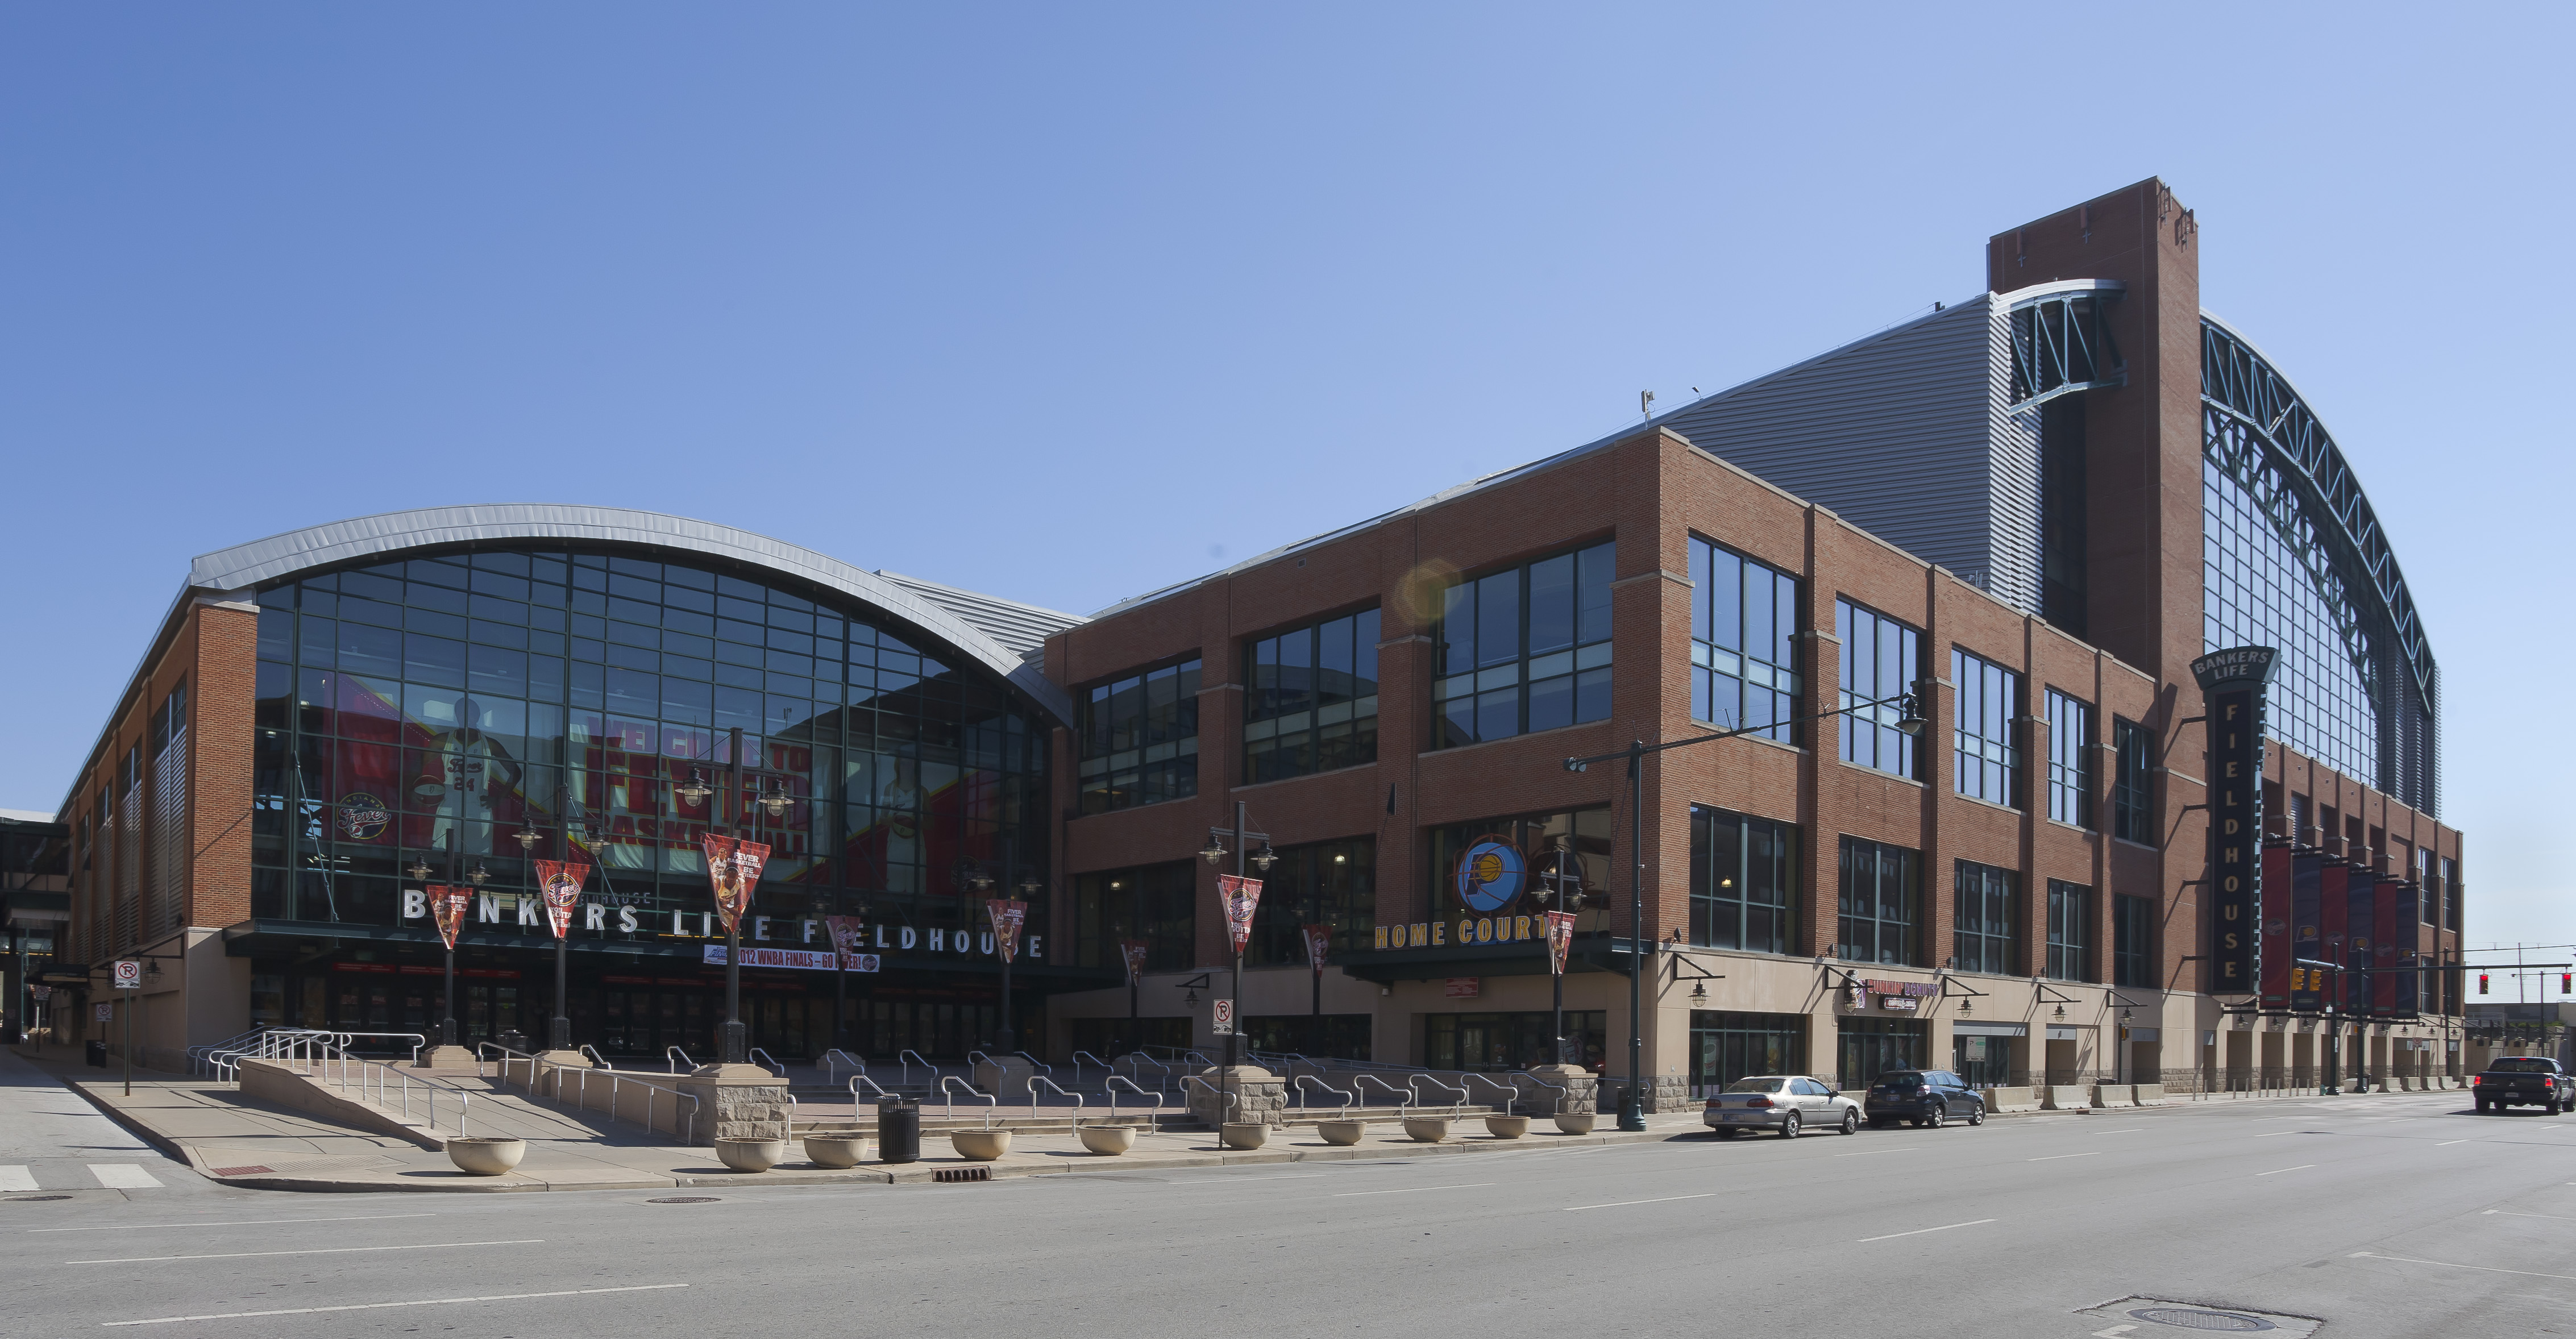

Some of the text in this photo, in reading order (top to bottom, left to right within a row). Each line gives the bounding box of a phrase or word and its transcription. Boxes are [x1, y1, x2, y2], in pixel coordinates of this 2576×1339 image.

[2195, 651, 2269, 674] BANKERS
[2214, 664, 2249, 680] LIFE
[768, 743, 810, 772] TO
[454, 777, 475, 792] 24
[585, 747, 810, 832] FEVER
[336, 803, 392, 829] Fever
[584, 812, 804, 860] BASKEALL
[2224, 704, 2239, 978] FIELDHOUSE
[728, 858, 761, 868] BASKETBALL
[734, 852, 759, 863] FEVER
[547, 881, 579, 899] Fever
[404, 889, 1041, 957] BNKRS LIE FELDHOUE
[1375, 922, 1445, 949] HOME
[1459, 914, 1546, 943] COURT
[738, 949, 756, 964] 012
[757, 950, 784, 966] WNBA
[786, 951, 814, 968] FINALS
[822, 954, 833, 968] GO
